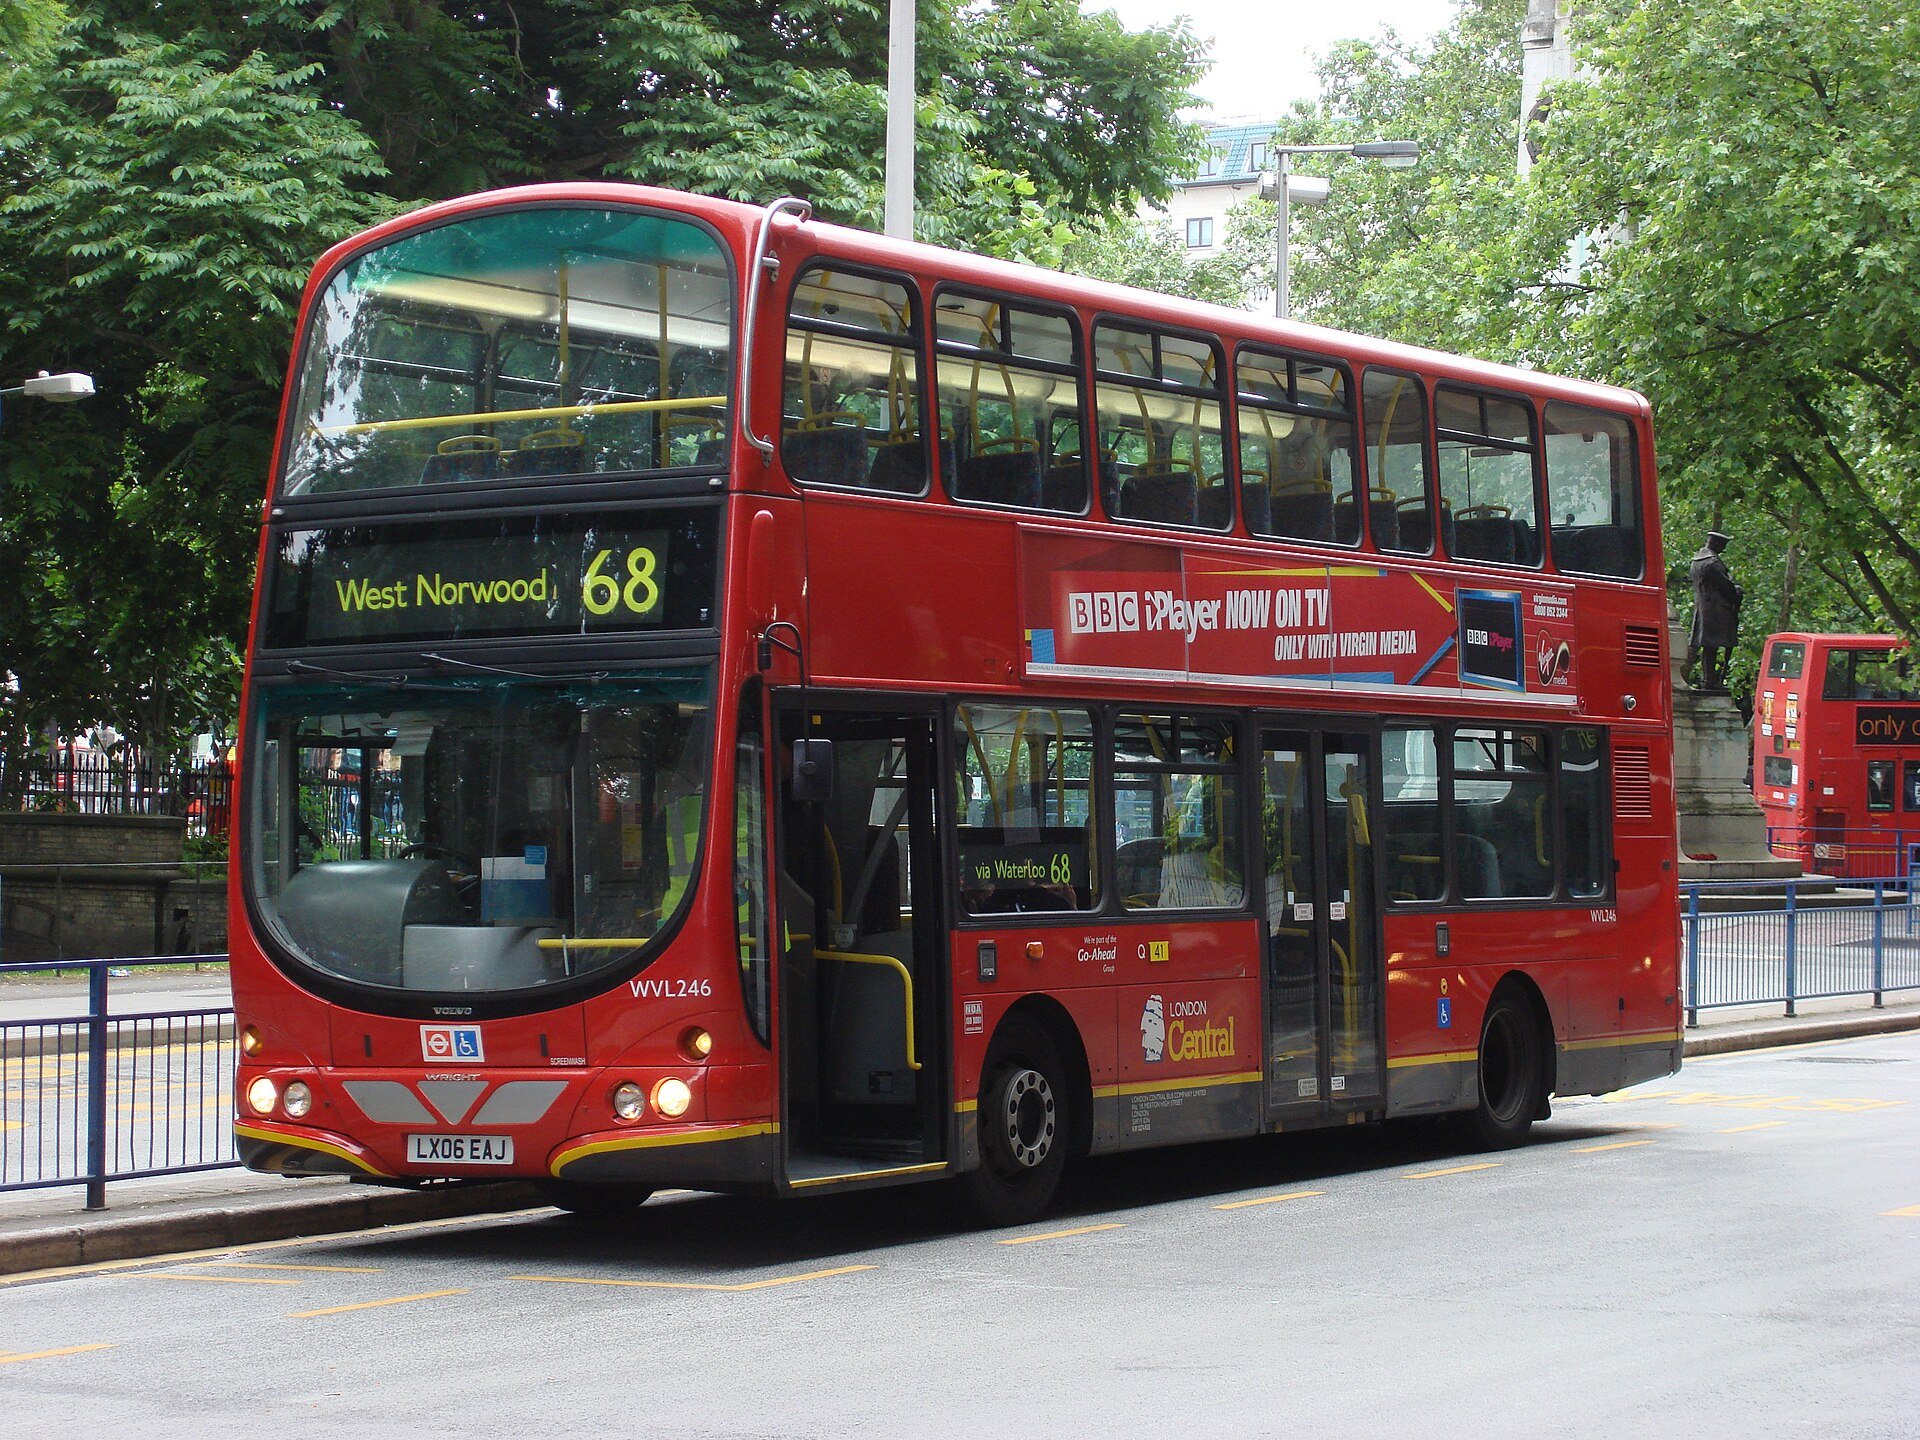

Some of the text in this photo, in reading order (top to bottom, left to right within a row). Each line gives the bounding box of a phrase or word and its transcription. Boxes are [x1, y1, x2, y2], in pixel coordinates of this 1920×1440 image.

[336, 568, 546, 612] West Norwood
[583, 546, 659, 615] 68
[1071, 589, 1329, 643] BBC iPlayer NOW ON TV
[1275, 630, 1417, 661] ONLY WITH VIRGIN MEDIA
[1468, 629, 1488, 645] BBC
[1553, 676, 1567, 685] media
[1860, 714, 1905, 740] only
[975, 859, 1046, 879] via Waterloo
[1051, 853, 1071, 884] 68
[1590, 909, 1617, 922] WVL246
[1077, 946, 1117, 962] Go-Ahead
[1137, 943, 1164, 959] Q 41
[1103, 964, 1115, 974] Group
[630, 978, 712, 999] WVL246
[433, 1006, 472, 1015] VOLVO
[1169, 1000, 1207, 1018] LONDON
[1167, 1016, 1235, 1062] Central
[550, 1057, 585, 1066] SCREENWASH
[425, 1073, 481, 1082] WRIGHT
[417, 1138, 506, 1160] LX06 EAJ
